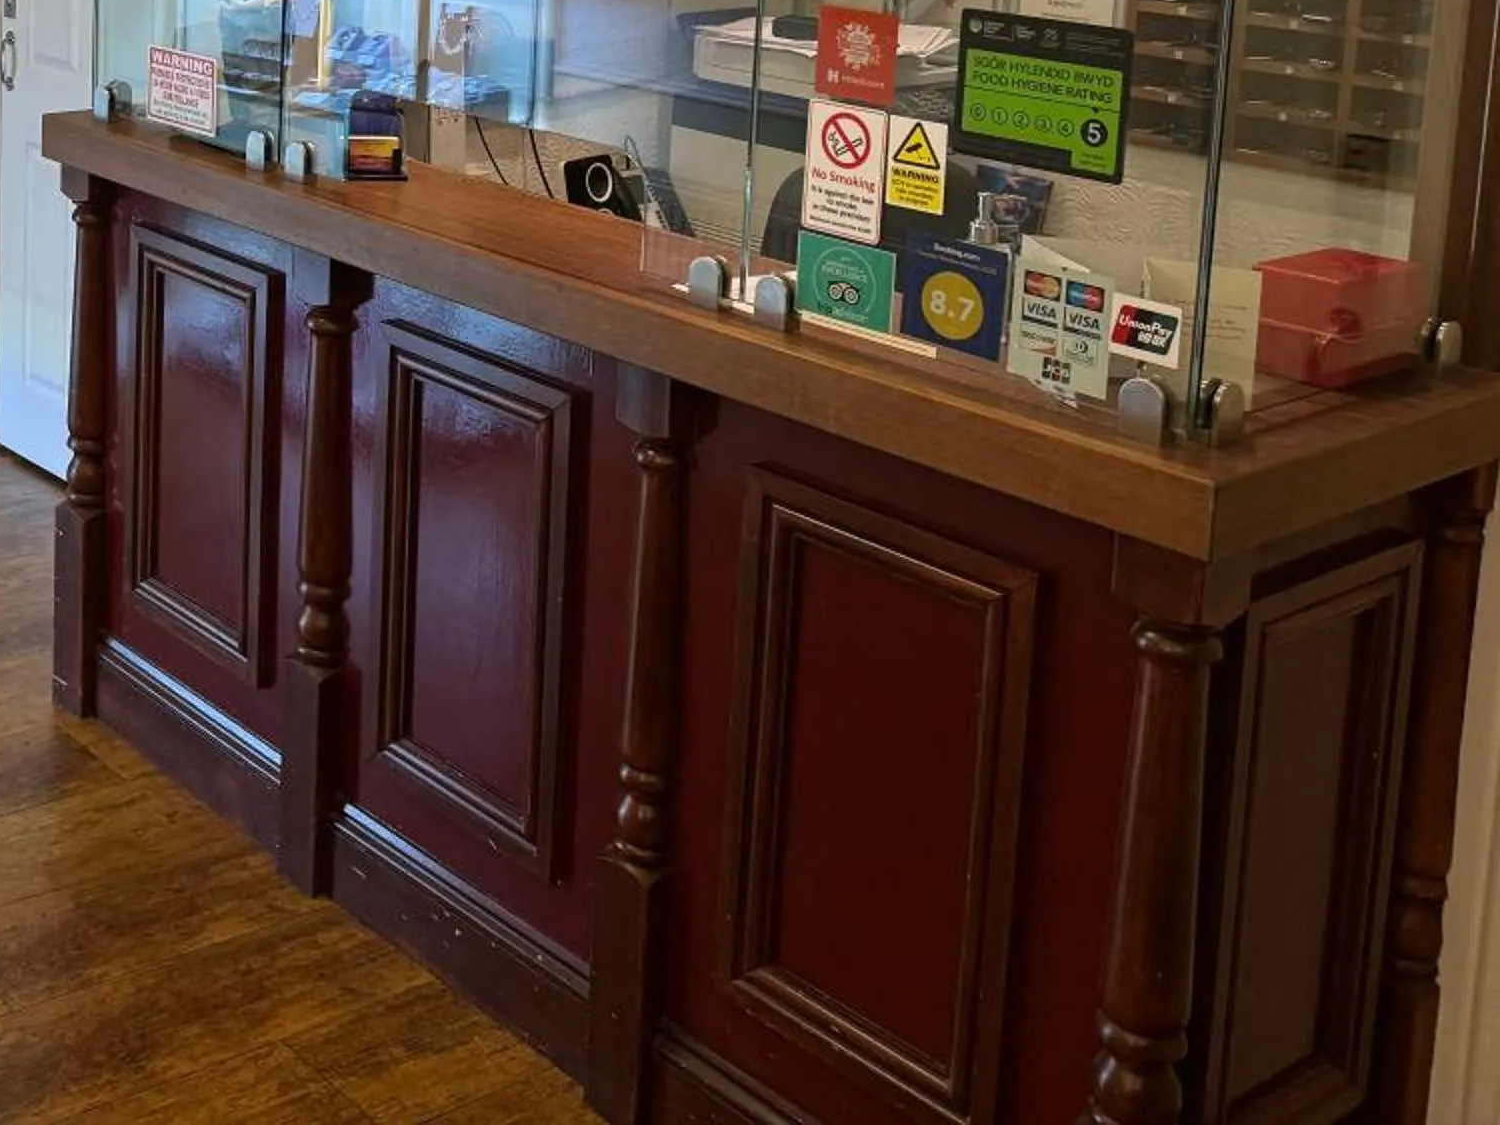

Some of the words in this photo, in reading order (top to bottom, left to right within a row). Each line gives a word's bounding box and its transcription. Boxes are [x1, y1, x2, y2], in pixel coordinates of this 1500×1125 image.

[152, 49, 213, 75] WARNING
[974, 71, 1008, 86] FOOD
[1012, 75, 1066, 95] HYGIENE
[1067, 85, 1113, 103] RATING
[1087, 122, 1102, 143] 5
[812, 167, 827, 179] No
[829, 170, 875, 193] Smoking
[891, 166, 939, 184] WARNING
[930, 290, 975, 323] 8.7
[1027, 300, 1057, 318] VISA
[1069, 313, 1100, 330] VISA
[1119, 316, 1174, 340] UnionPay
